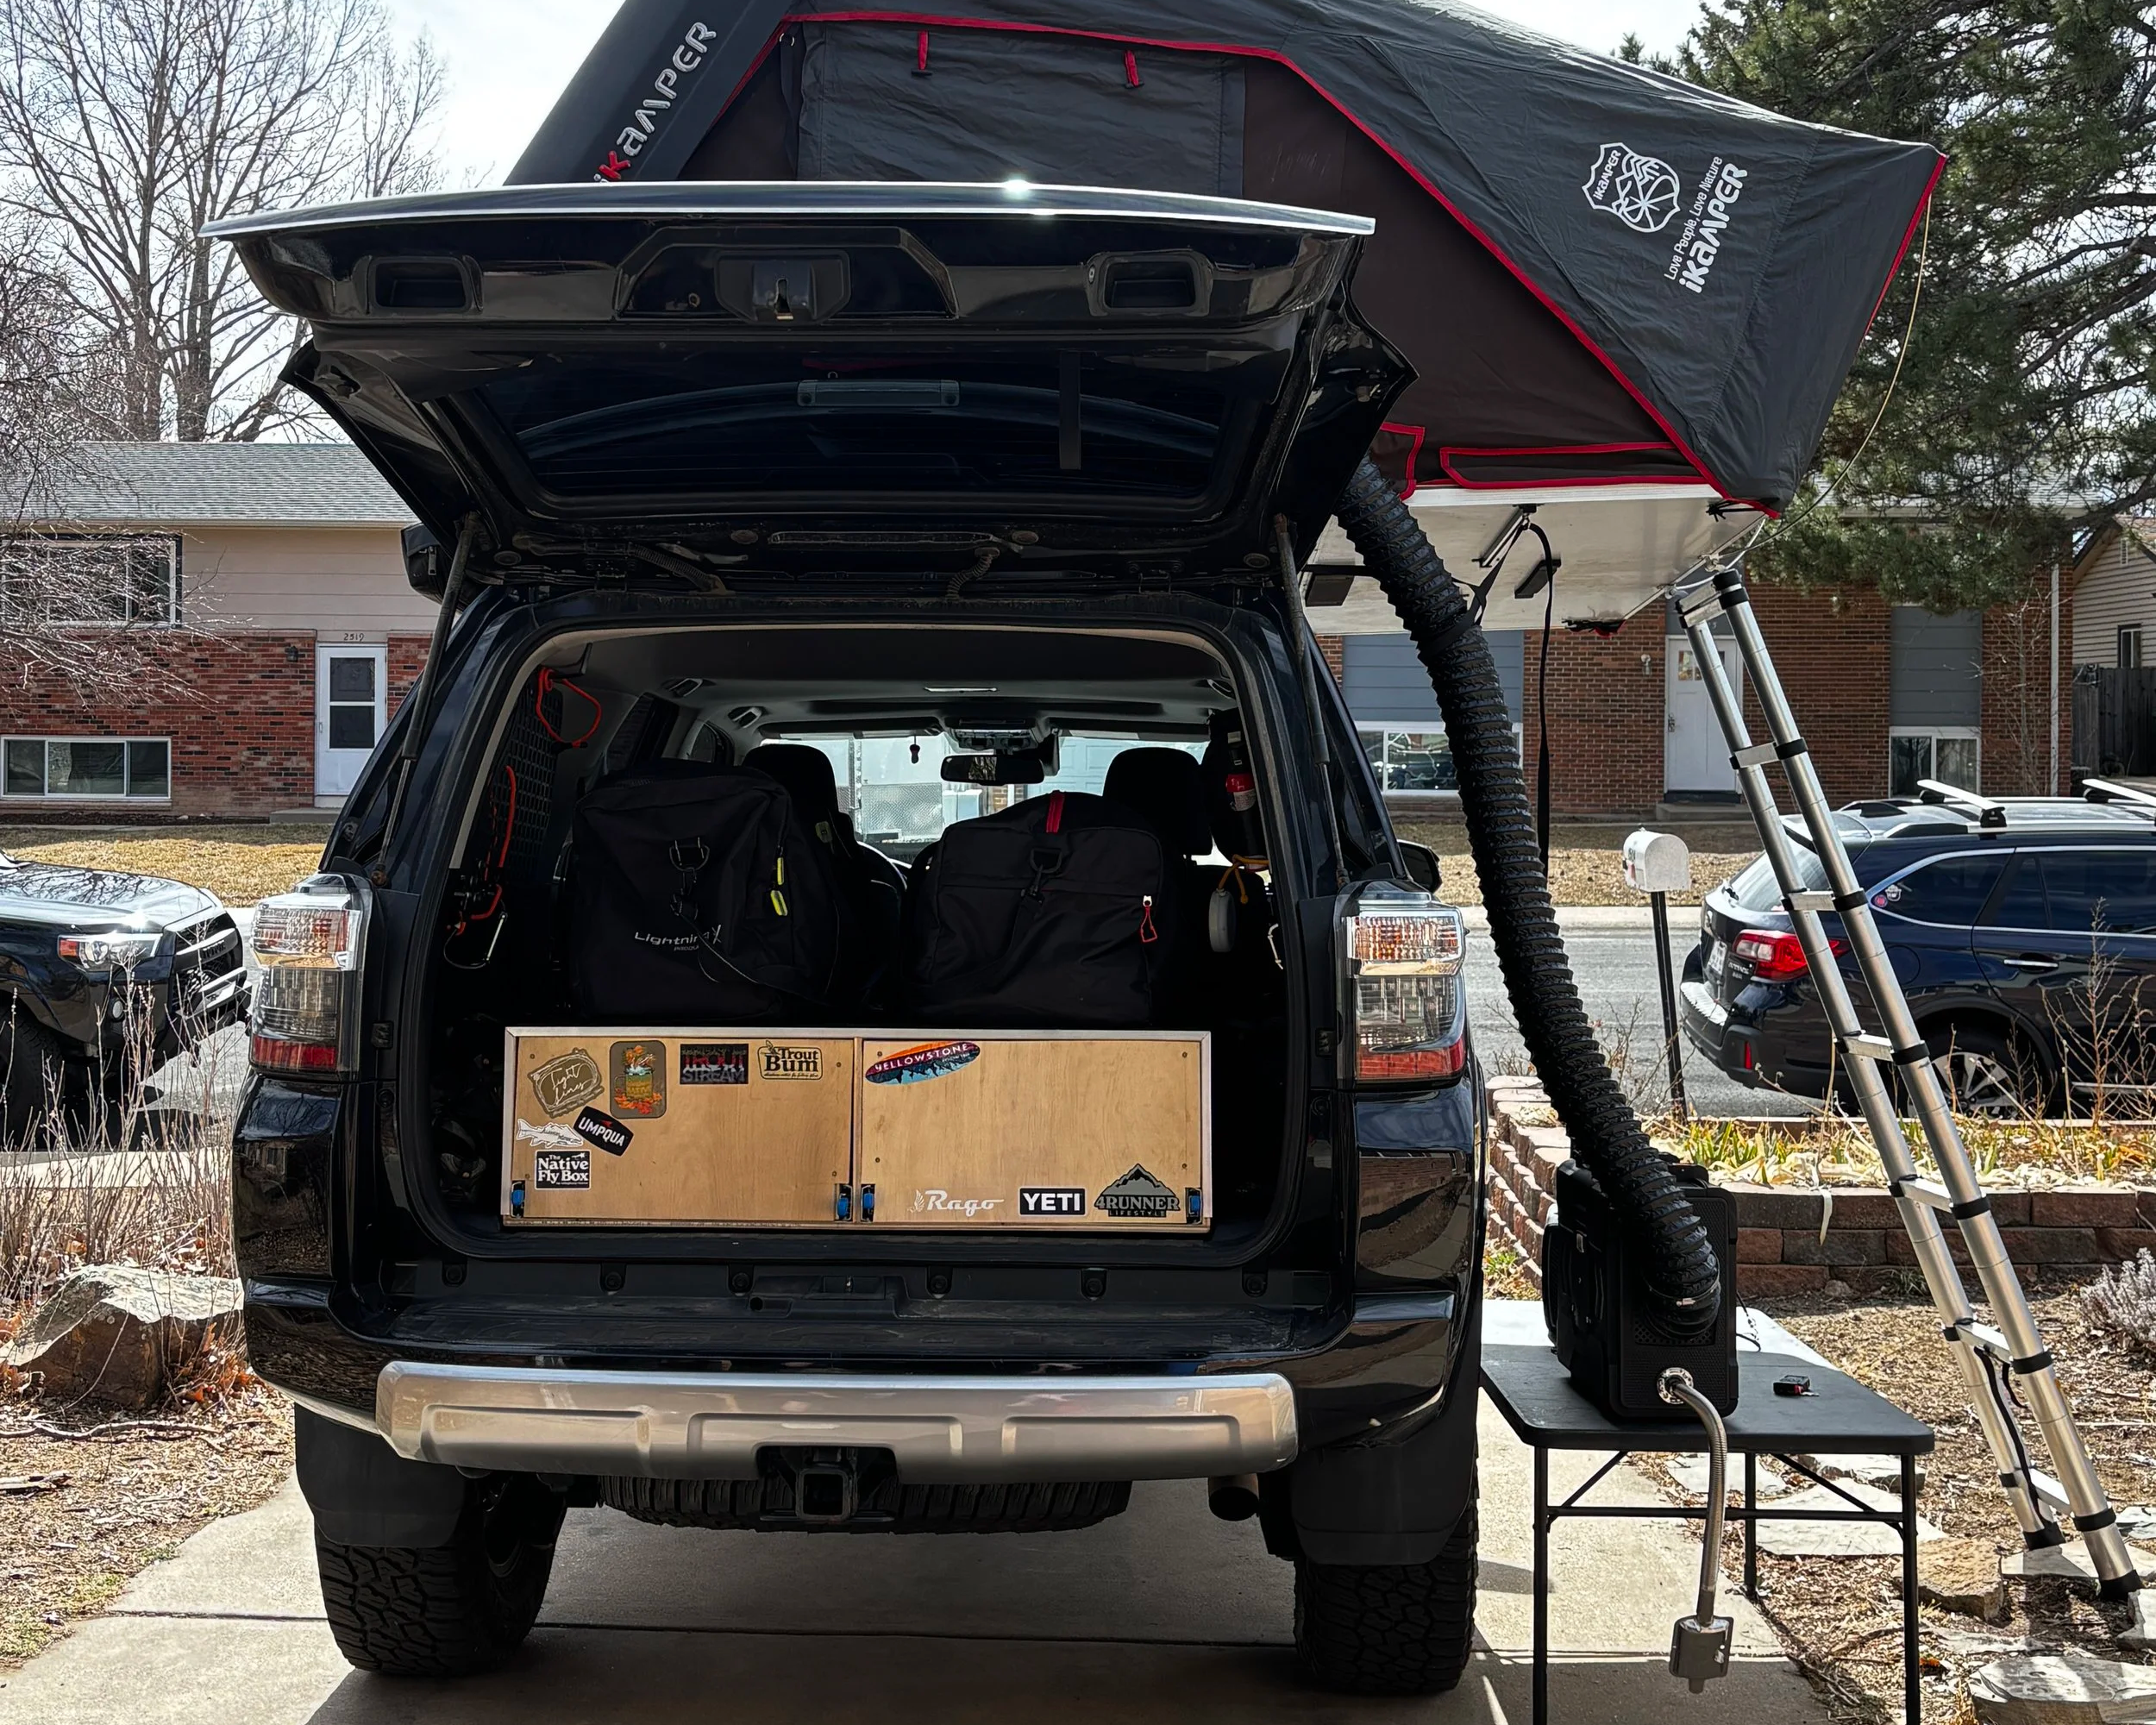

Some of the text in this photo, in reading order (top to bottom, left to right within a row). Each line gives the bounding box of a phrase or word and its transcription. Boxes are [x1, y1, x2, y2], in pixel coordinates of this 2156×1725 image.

[1664, 156, 1723, 280] Love People, Love Nature
[764, 1055, 819, 1072] Bum
[778, 1048, 818, 1061] Trout
[874, 1043, 968, 1072] YELLOWSTONE
[578, 1116, 625, 1147] UMPQUA
[537, 1157, 589, 1170] Native
[537, 1170, 560, 1184] Fly
[561, 1170, 589, 1182] Box
[925, 1190, 1005, 1217] Rago
[1023, 1193, 1081, 1212] YETI
[1094, 1195, 1180, 1210] 4RUNNER
